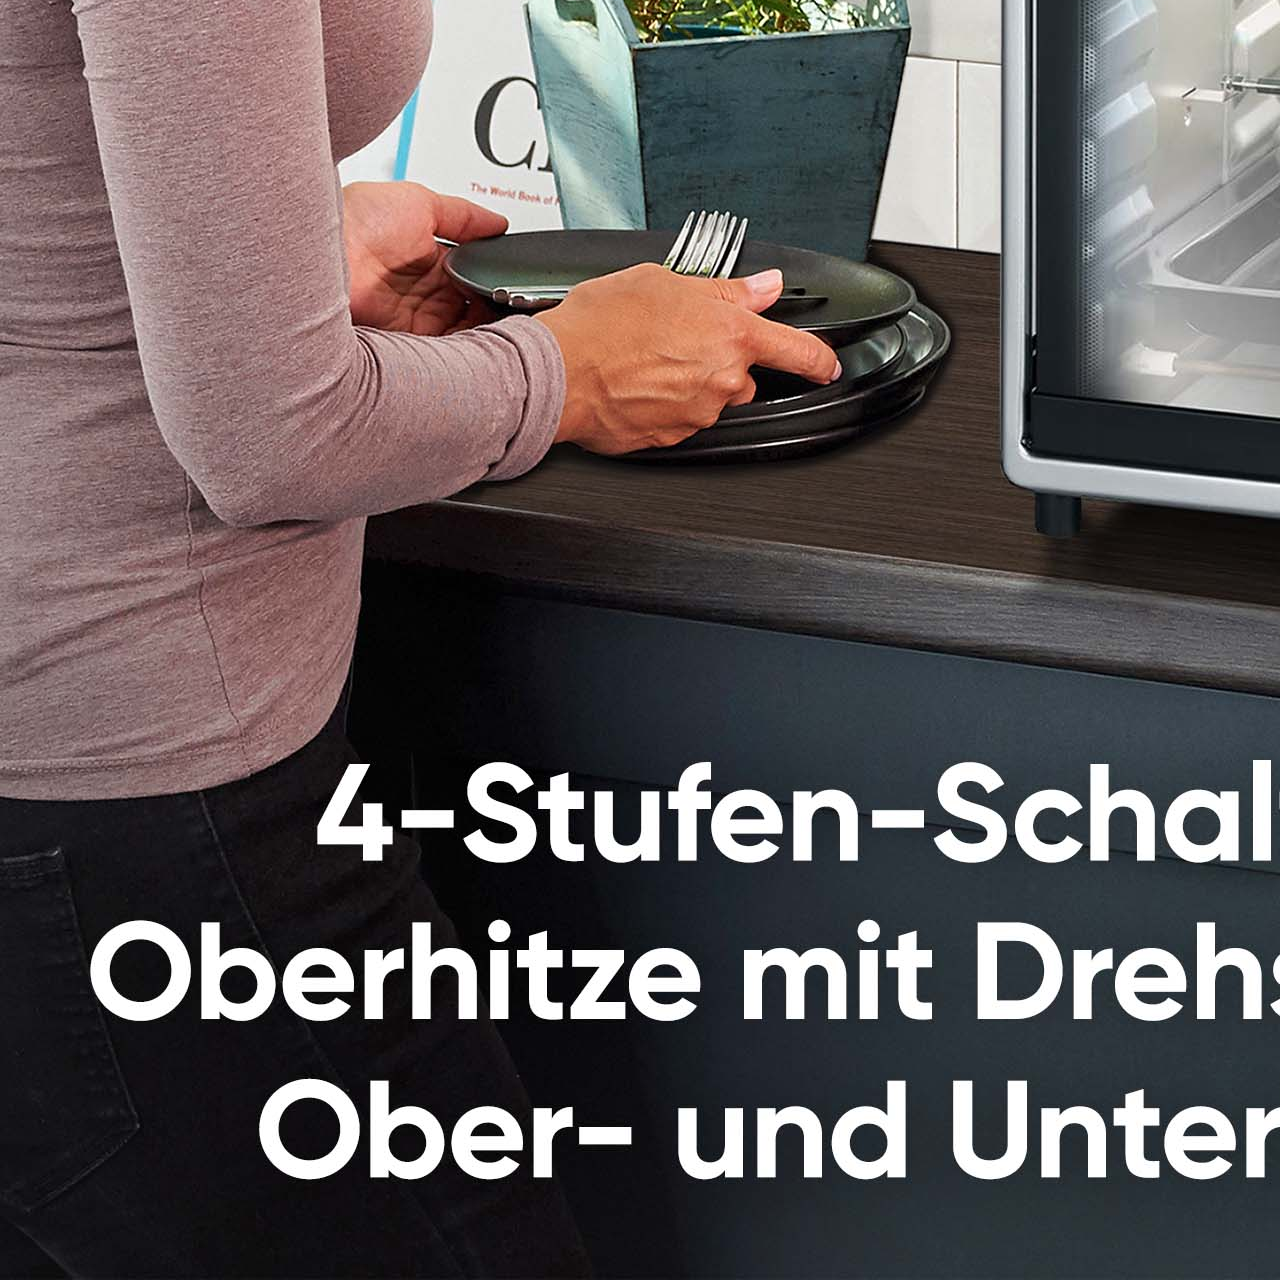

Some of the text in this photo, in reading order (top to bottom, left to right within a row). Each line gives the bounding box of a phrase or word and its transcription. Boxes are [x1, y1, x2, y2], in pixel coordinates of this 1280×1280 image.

[471, 182, 487, 193] The
[490, 186, 516, 199] World
[518, 191, 541, 204] Book
[543, 196, 553, 205] of
